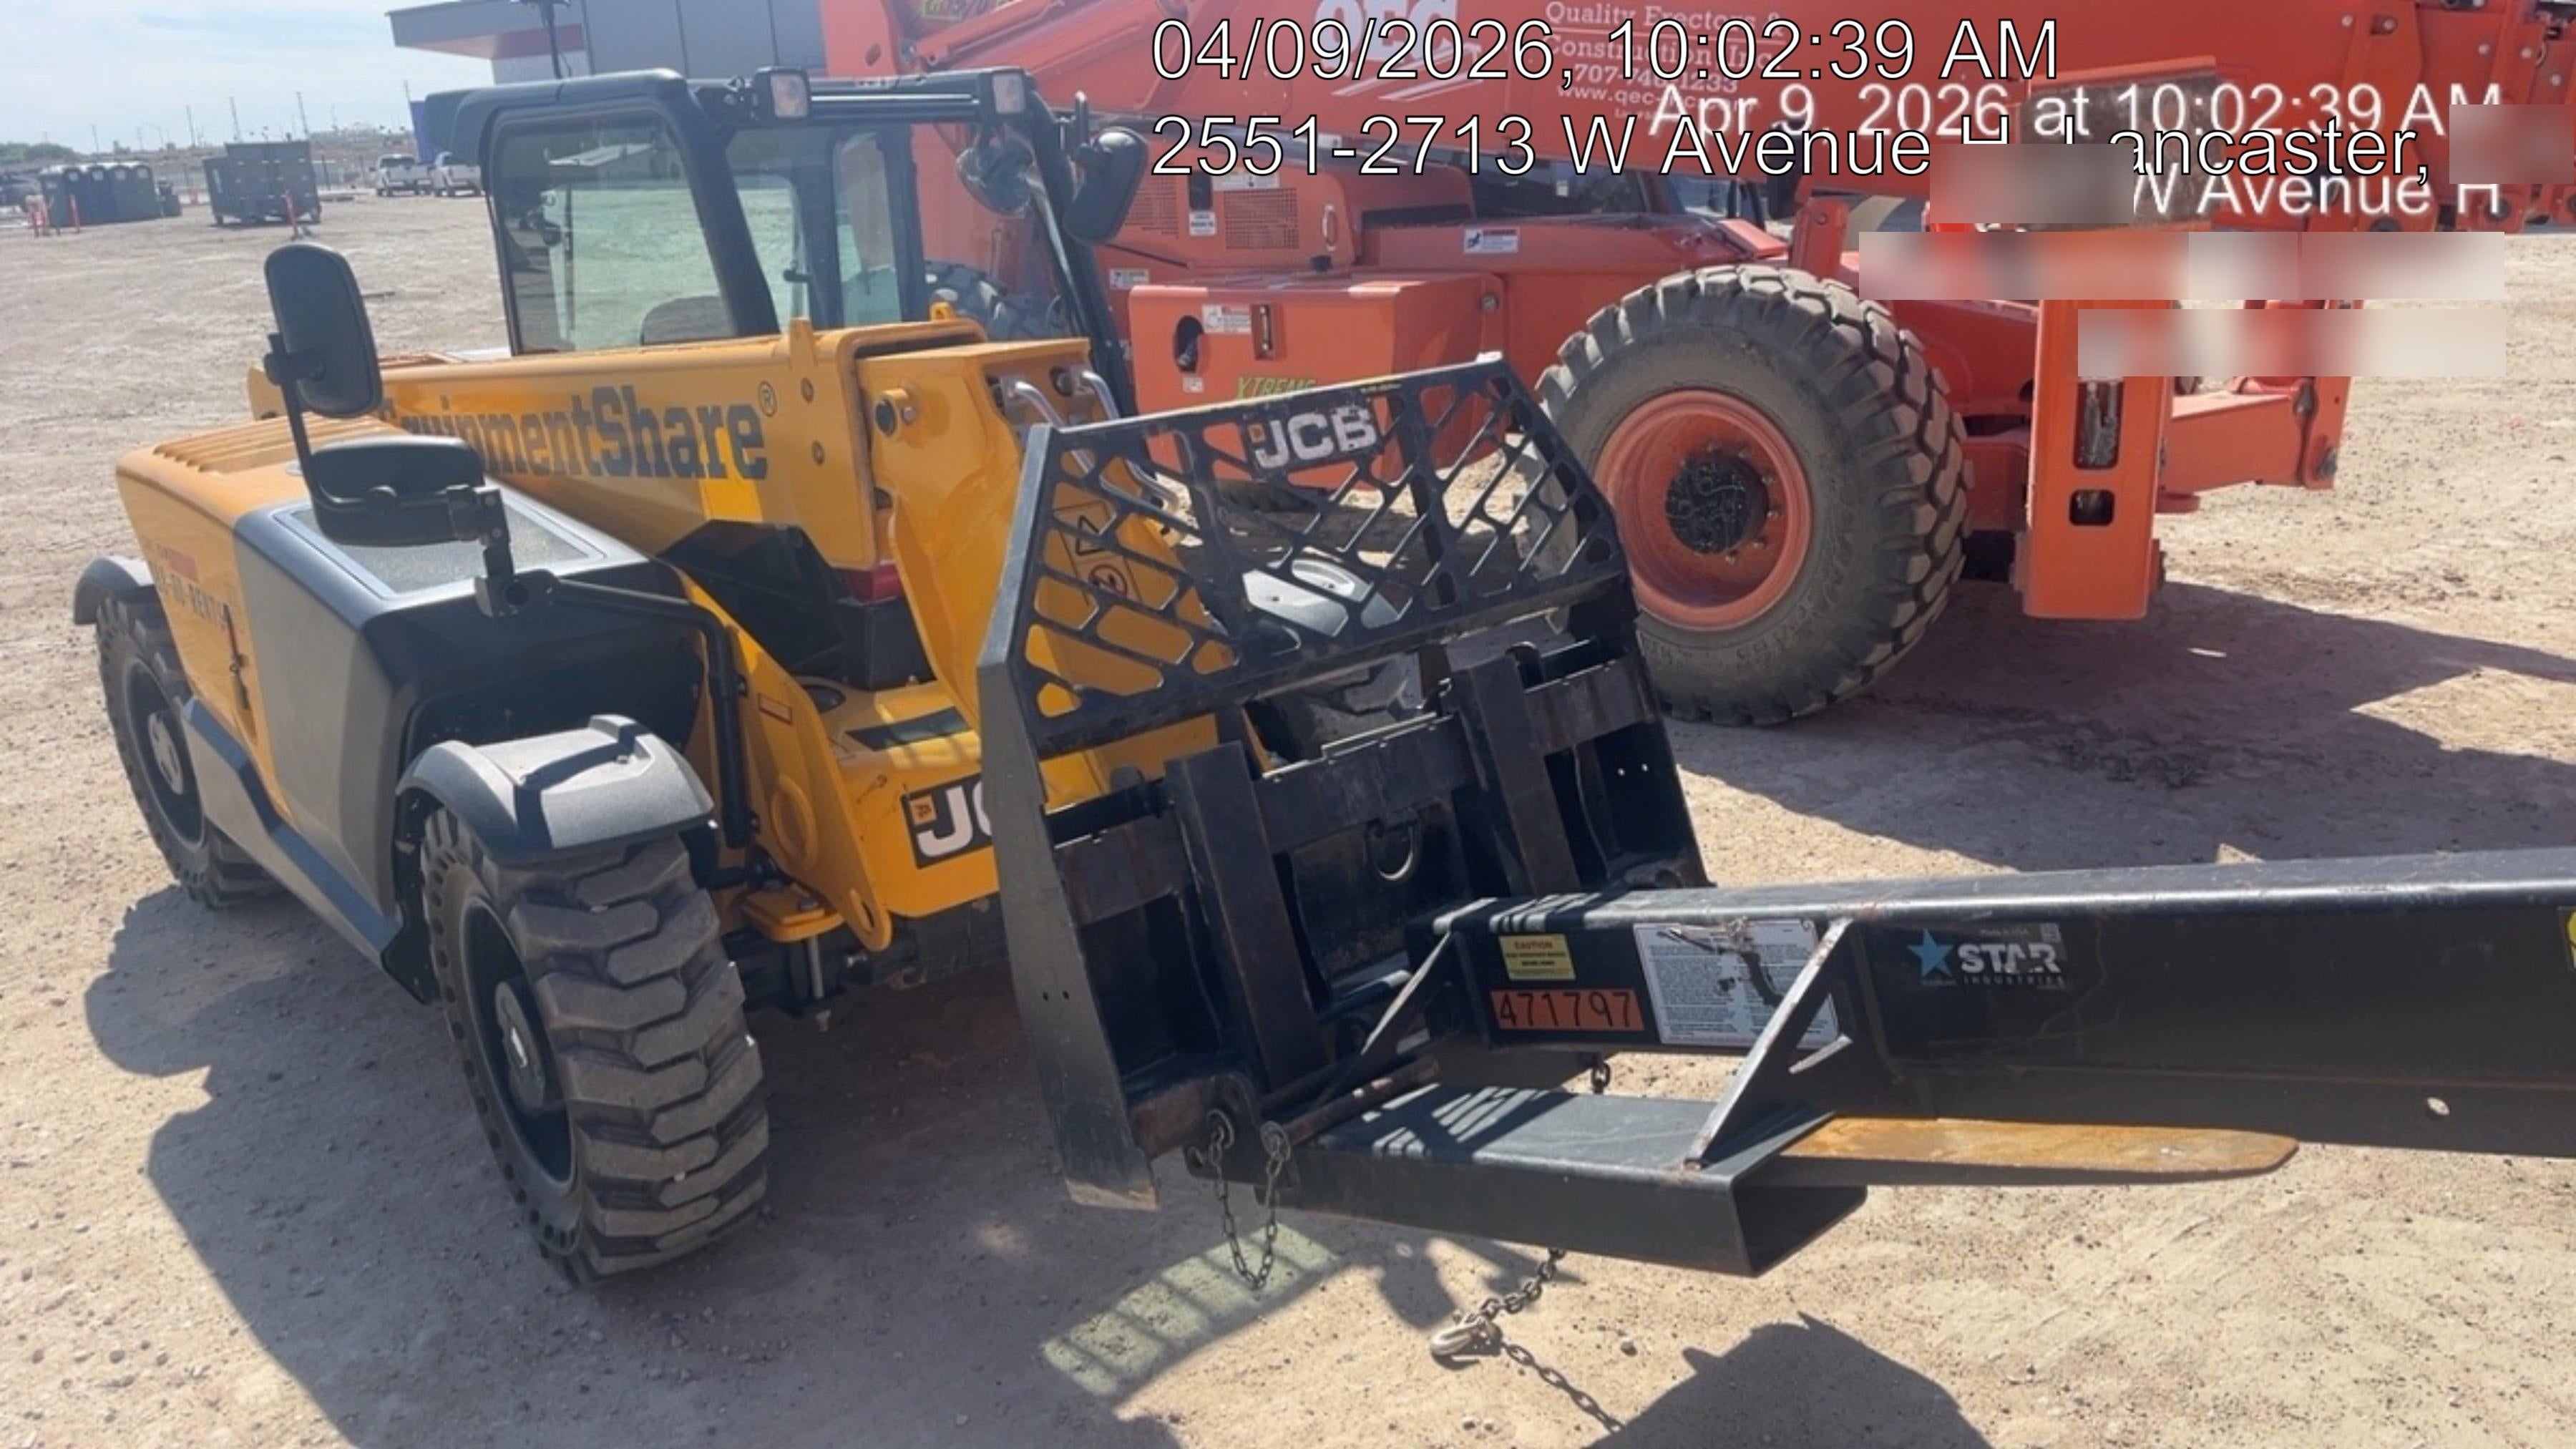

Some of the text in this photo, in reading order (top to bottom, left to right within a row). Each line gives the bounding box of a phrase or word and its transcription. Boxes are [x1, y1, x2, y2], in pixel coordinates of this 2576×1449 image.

[1546, 2, 1636, 27] Quality
[1254, 404, 1377, 469] JCB
[1958, 943, 2062, 974] STAR
[1499, 990, 1631, 1028] 471797
